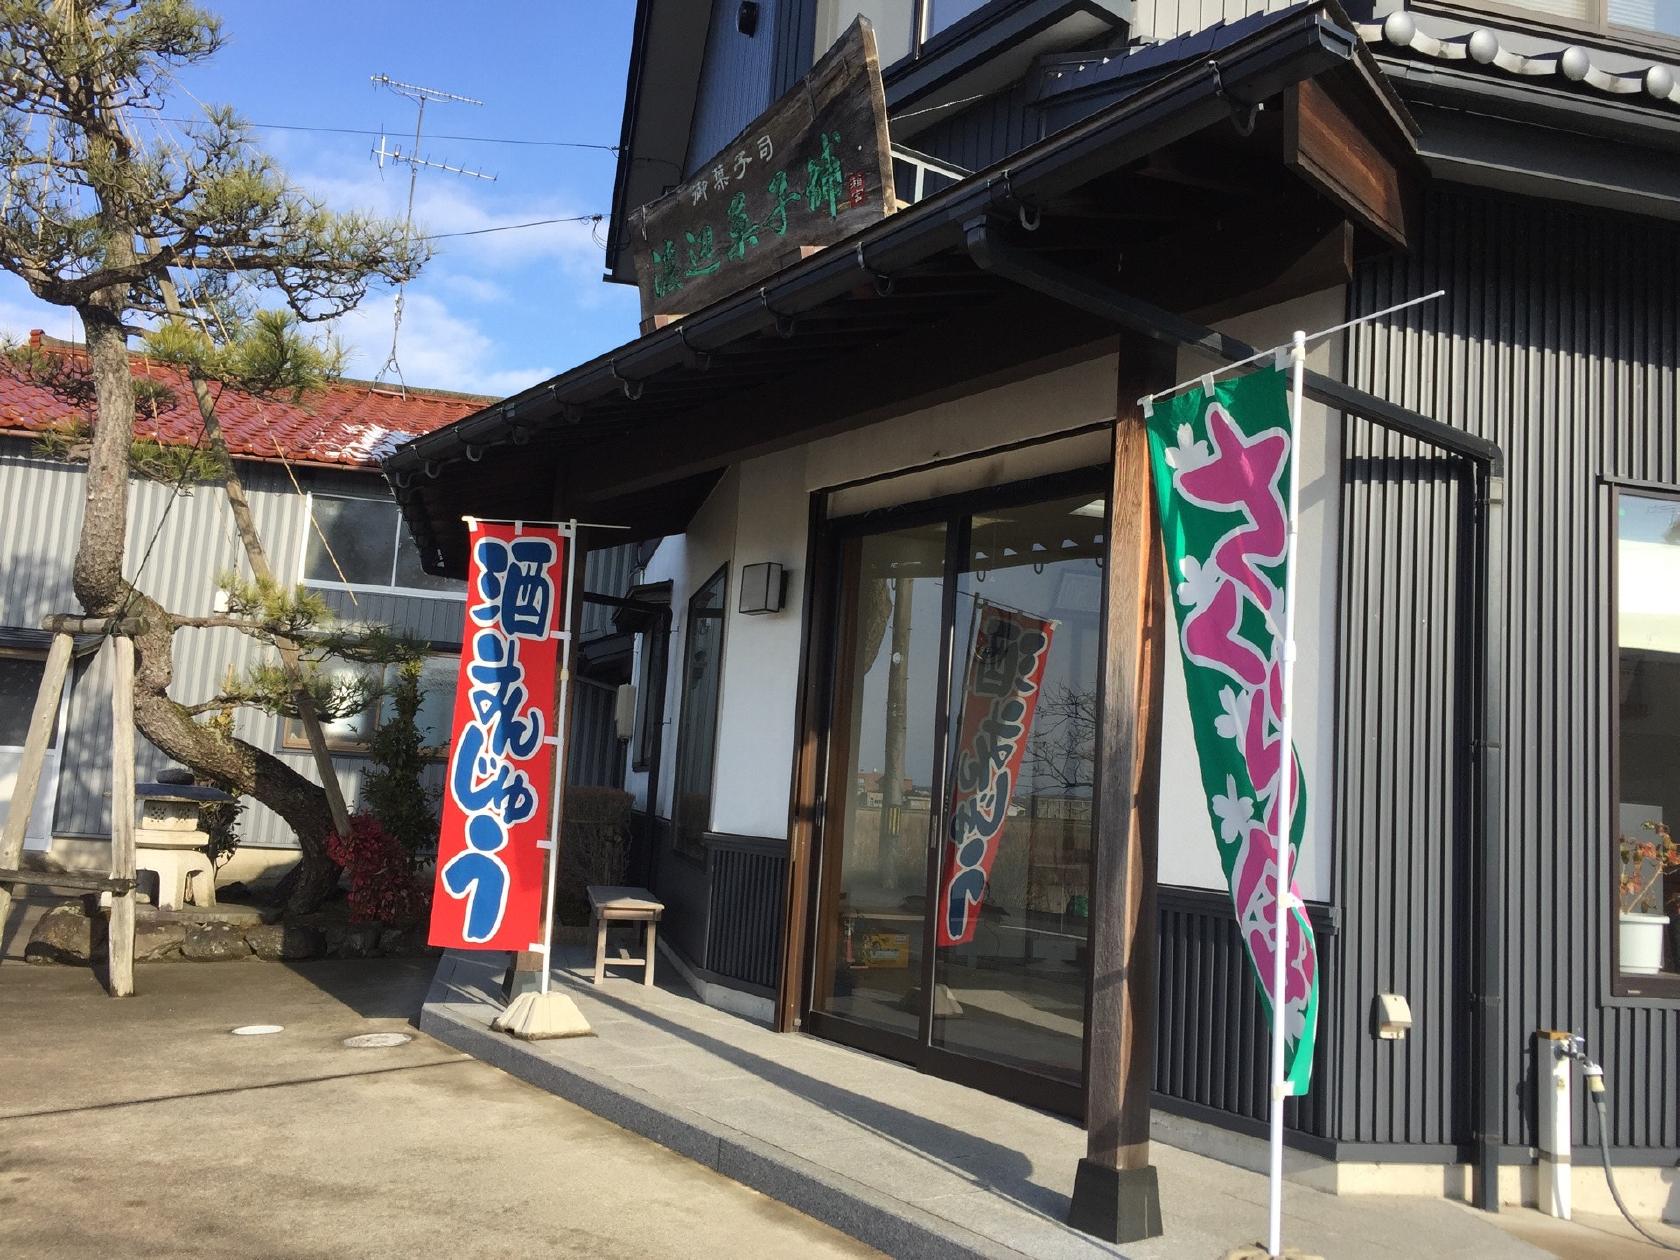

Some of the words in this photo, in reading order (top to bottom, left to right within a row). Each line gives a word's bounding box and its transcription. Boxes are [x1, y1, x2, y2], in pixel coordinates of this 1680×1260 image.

[691, 134, 774, 206] 御菓子司
[441, 536, 558, 943] 酒まんじゅう
